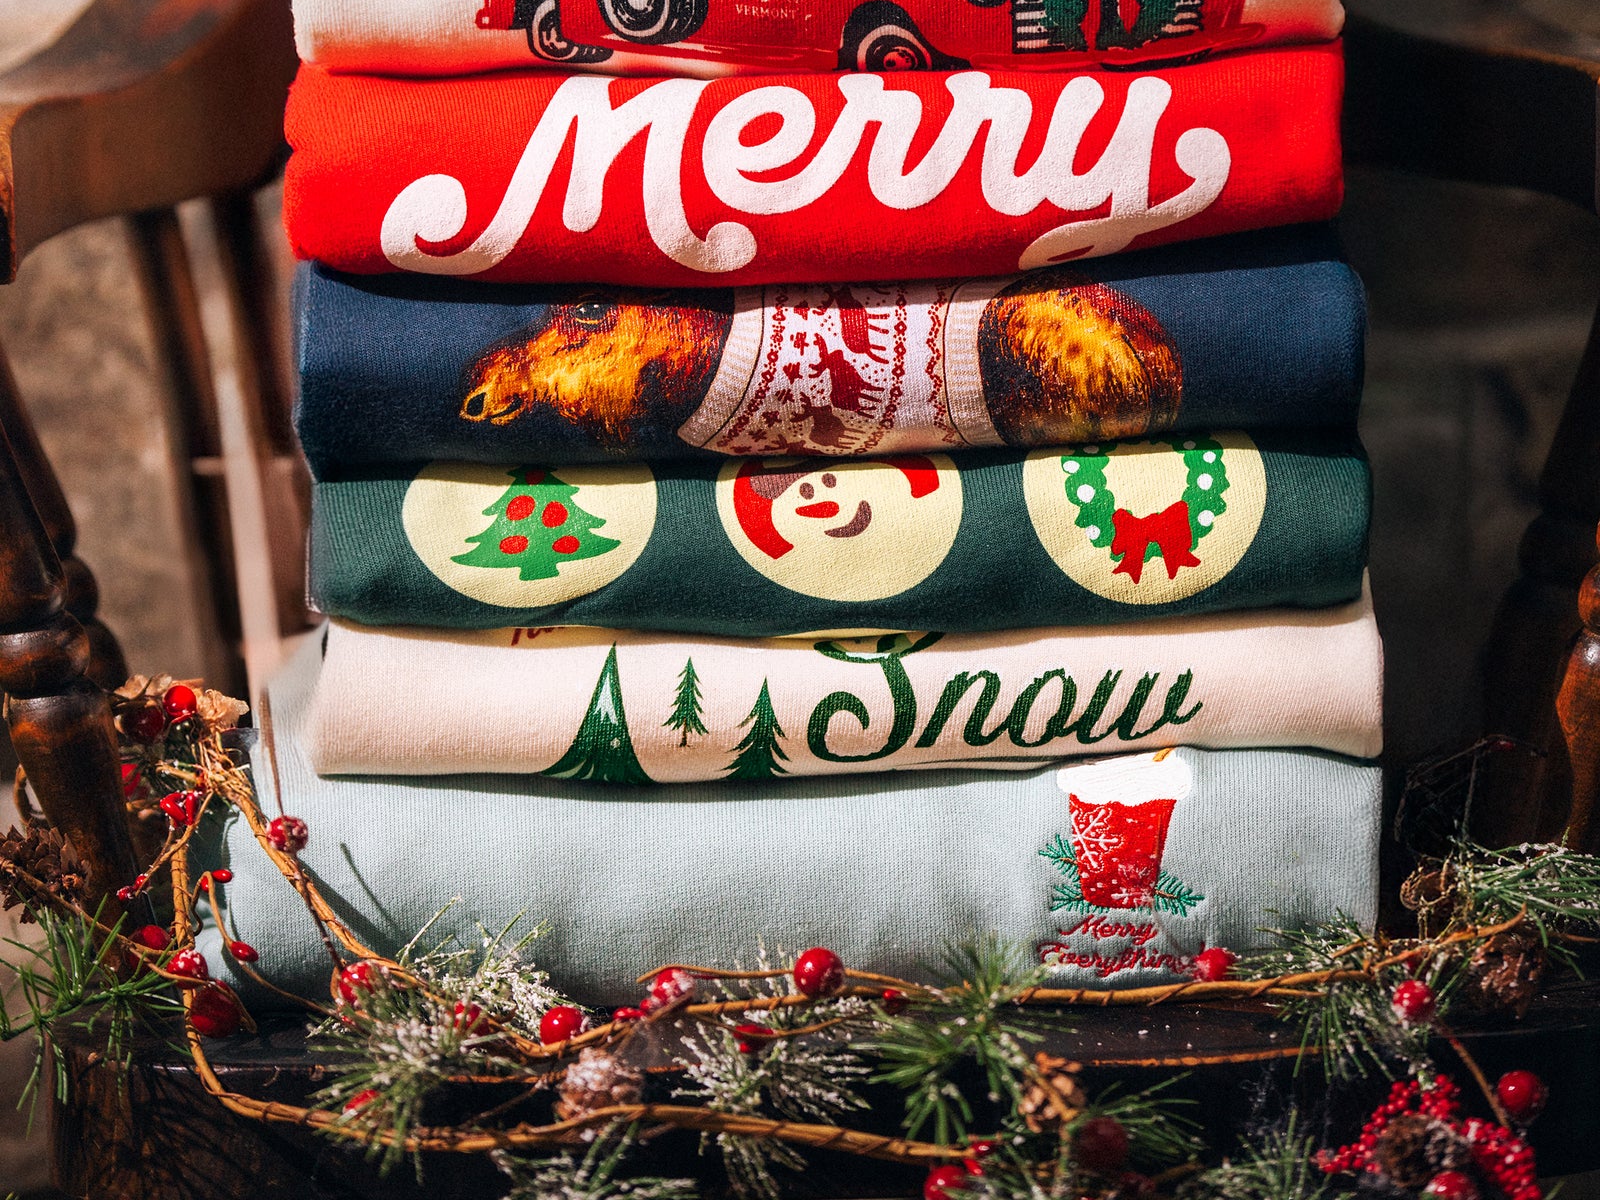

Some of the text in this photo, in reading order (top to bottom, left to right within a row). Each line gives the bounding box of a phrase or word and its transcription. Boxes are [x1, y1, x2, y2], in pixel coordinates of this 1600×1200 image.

[735, 3, 799, 20] VERMONT
[380, 71, 1232, 275] Merry
[807, 631, 1203, 763] Snow
[1058, 914, 1158, 946] Merry
